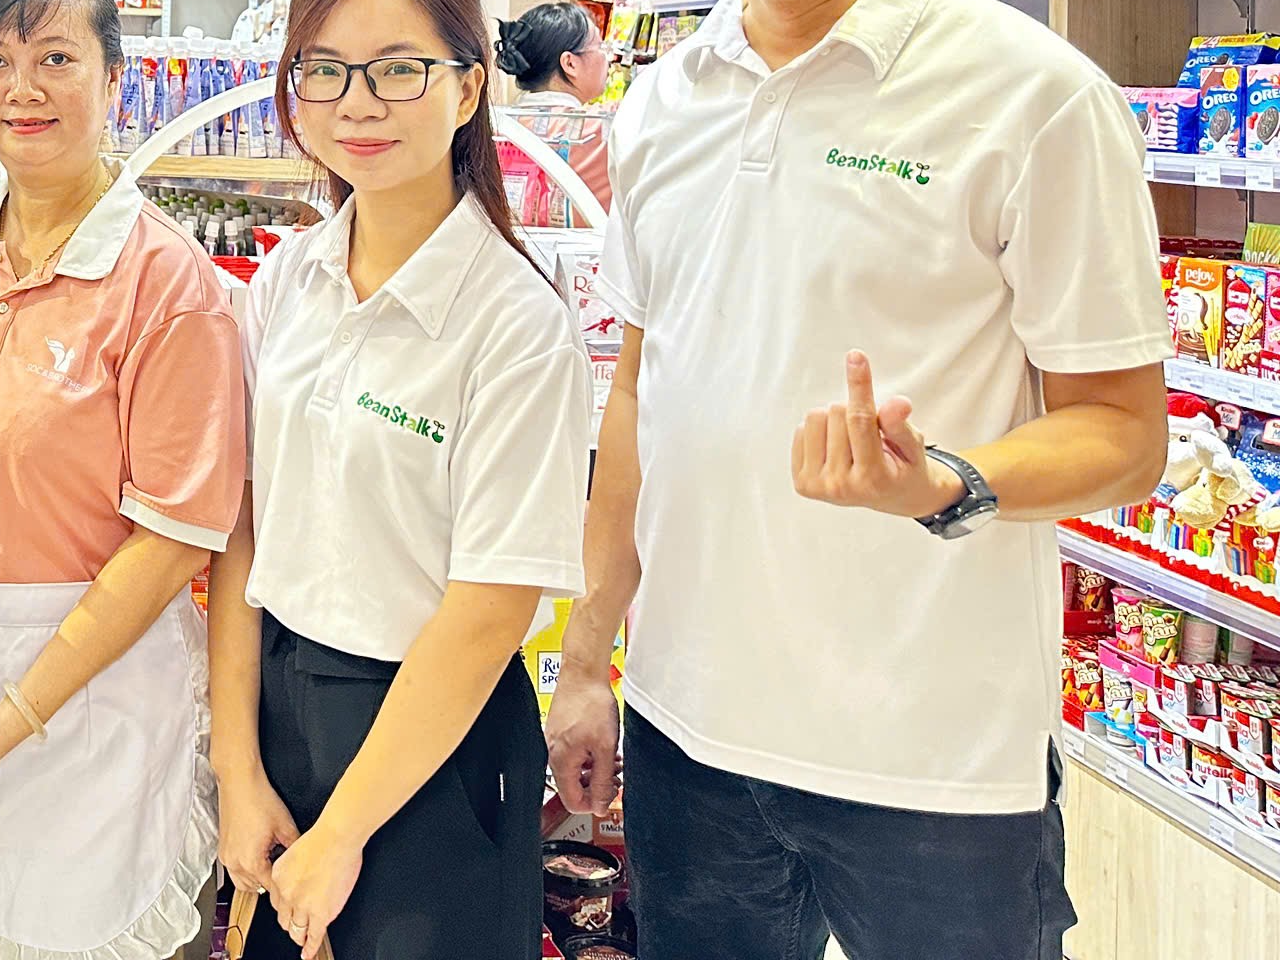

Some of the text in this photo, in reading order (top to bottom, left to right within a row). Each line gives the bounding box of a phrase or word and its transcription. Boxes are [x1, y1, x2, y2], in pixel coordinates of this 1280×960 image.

[1185, 55, 1218, 68] OREO
[1202, 93, 1238, 109] OREO
[1249, 88, 1280, 105] ORE
[826, 147, 914, 180] BeanStalk
[356, 391, 431, 438] BeanStalk
